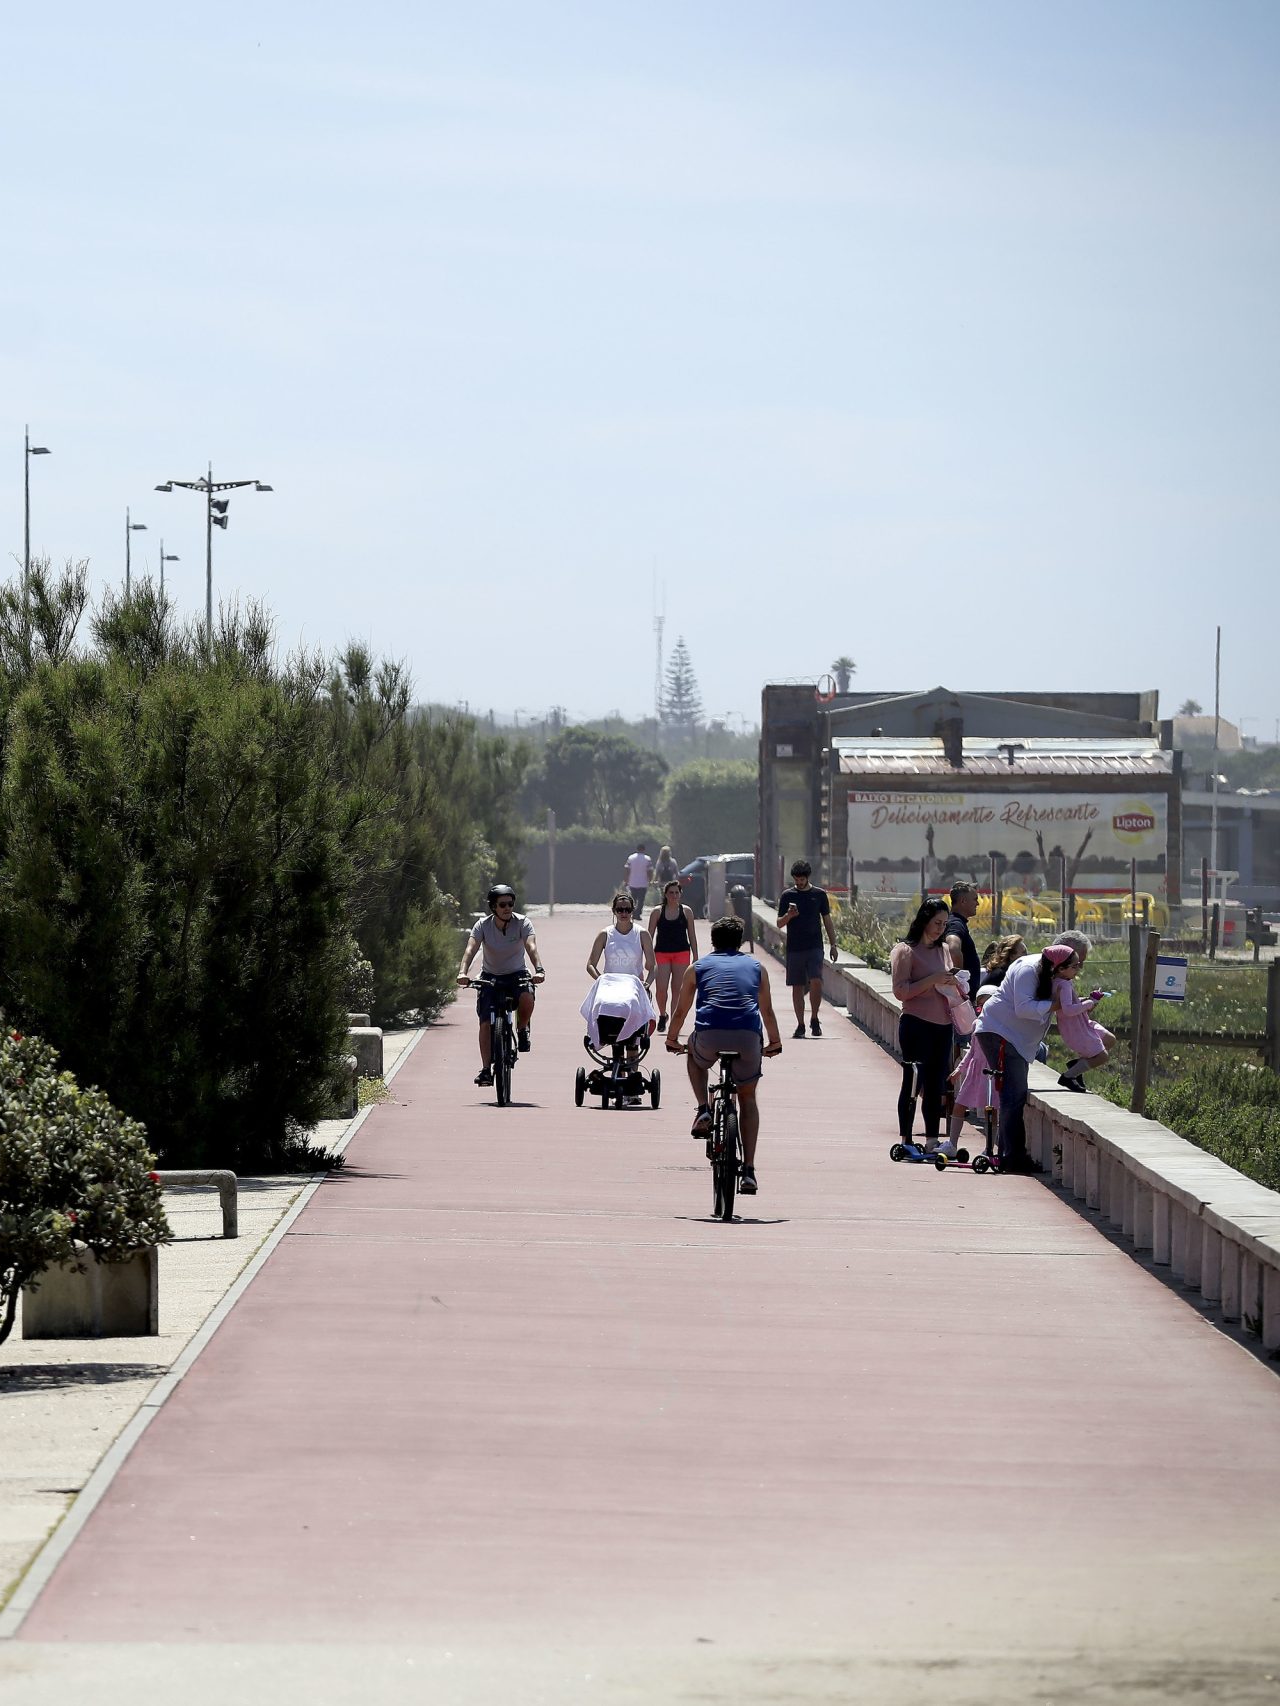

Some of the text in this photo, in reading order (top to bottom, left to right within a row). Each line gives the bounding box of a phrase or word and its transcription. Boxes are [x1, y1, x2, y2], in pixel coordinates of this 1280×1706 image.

[855, 793, 888, 802] BAIXO
[890, 794, 904, 803] EM
[871, 801, 1101, 831] Deliciosamente Refrescante
[1116, 817, 1151, 830] Lipton
[1165, 975, 1176, 986] 8
